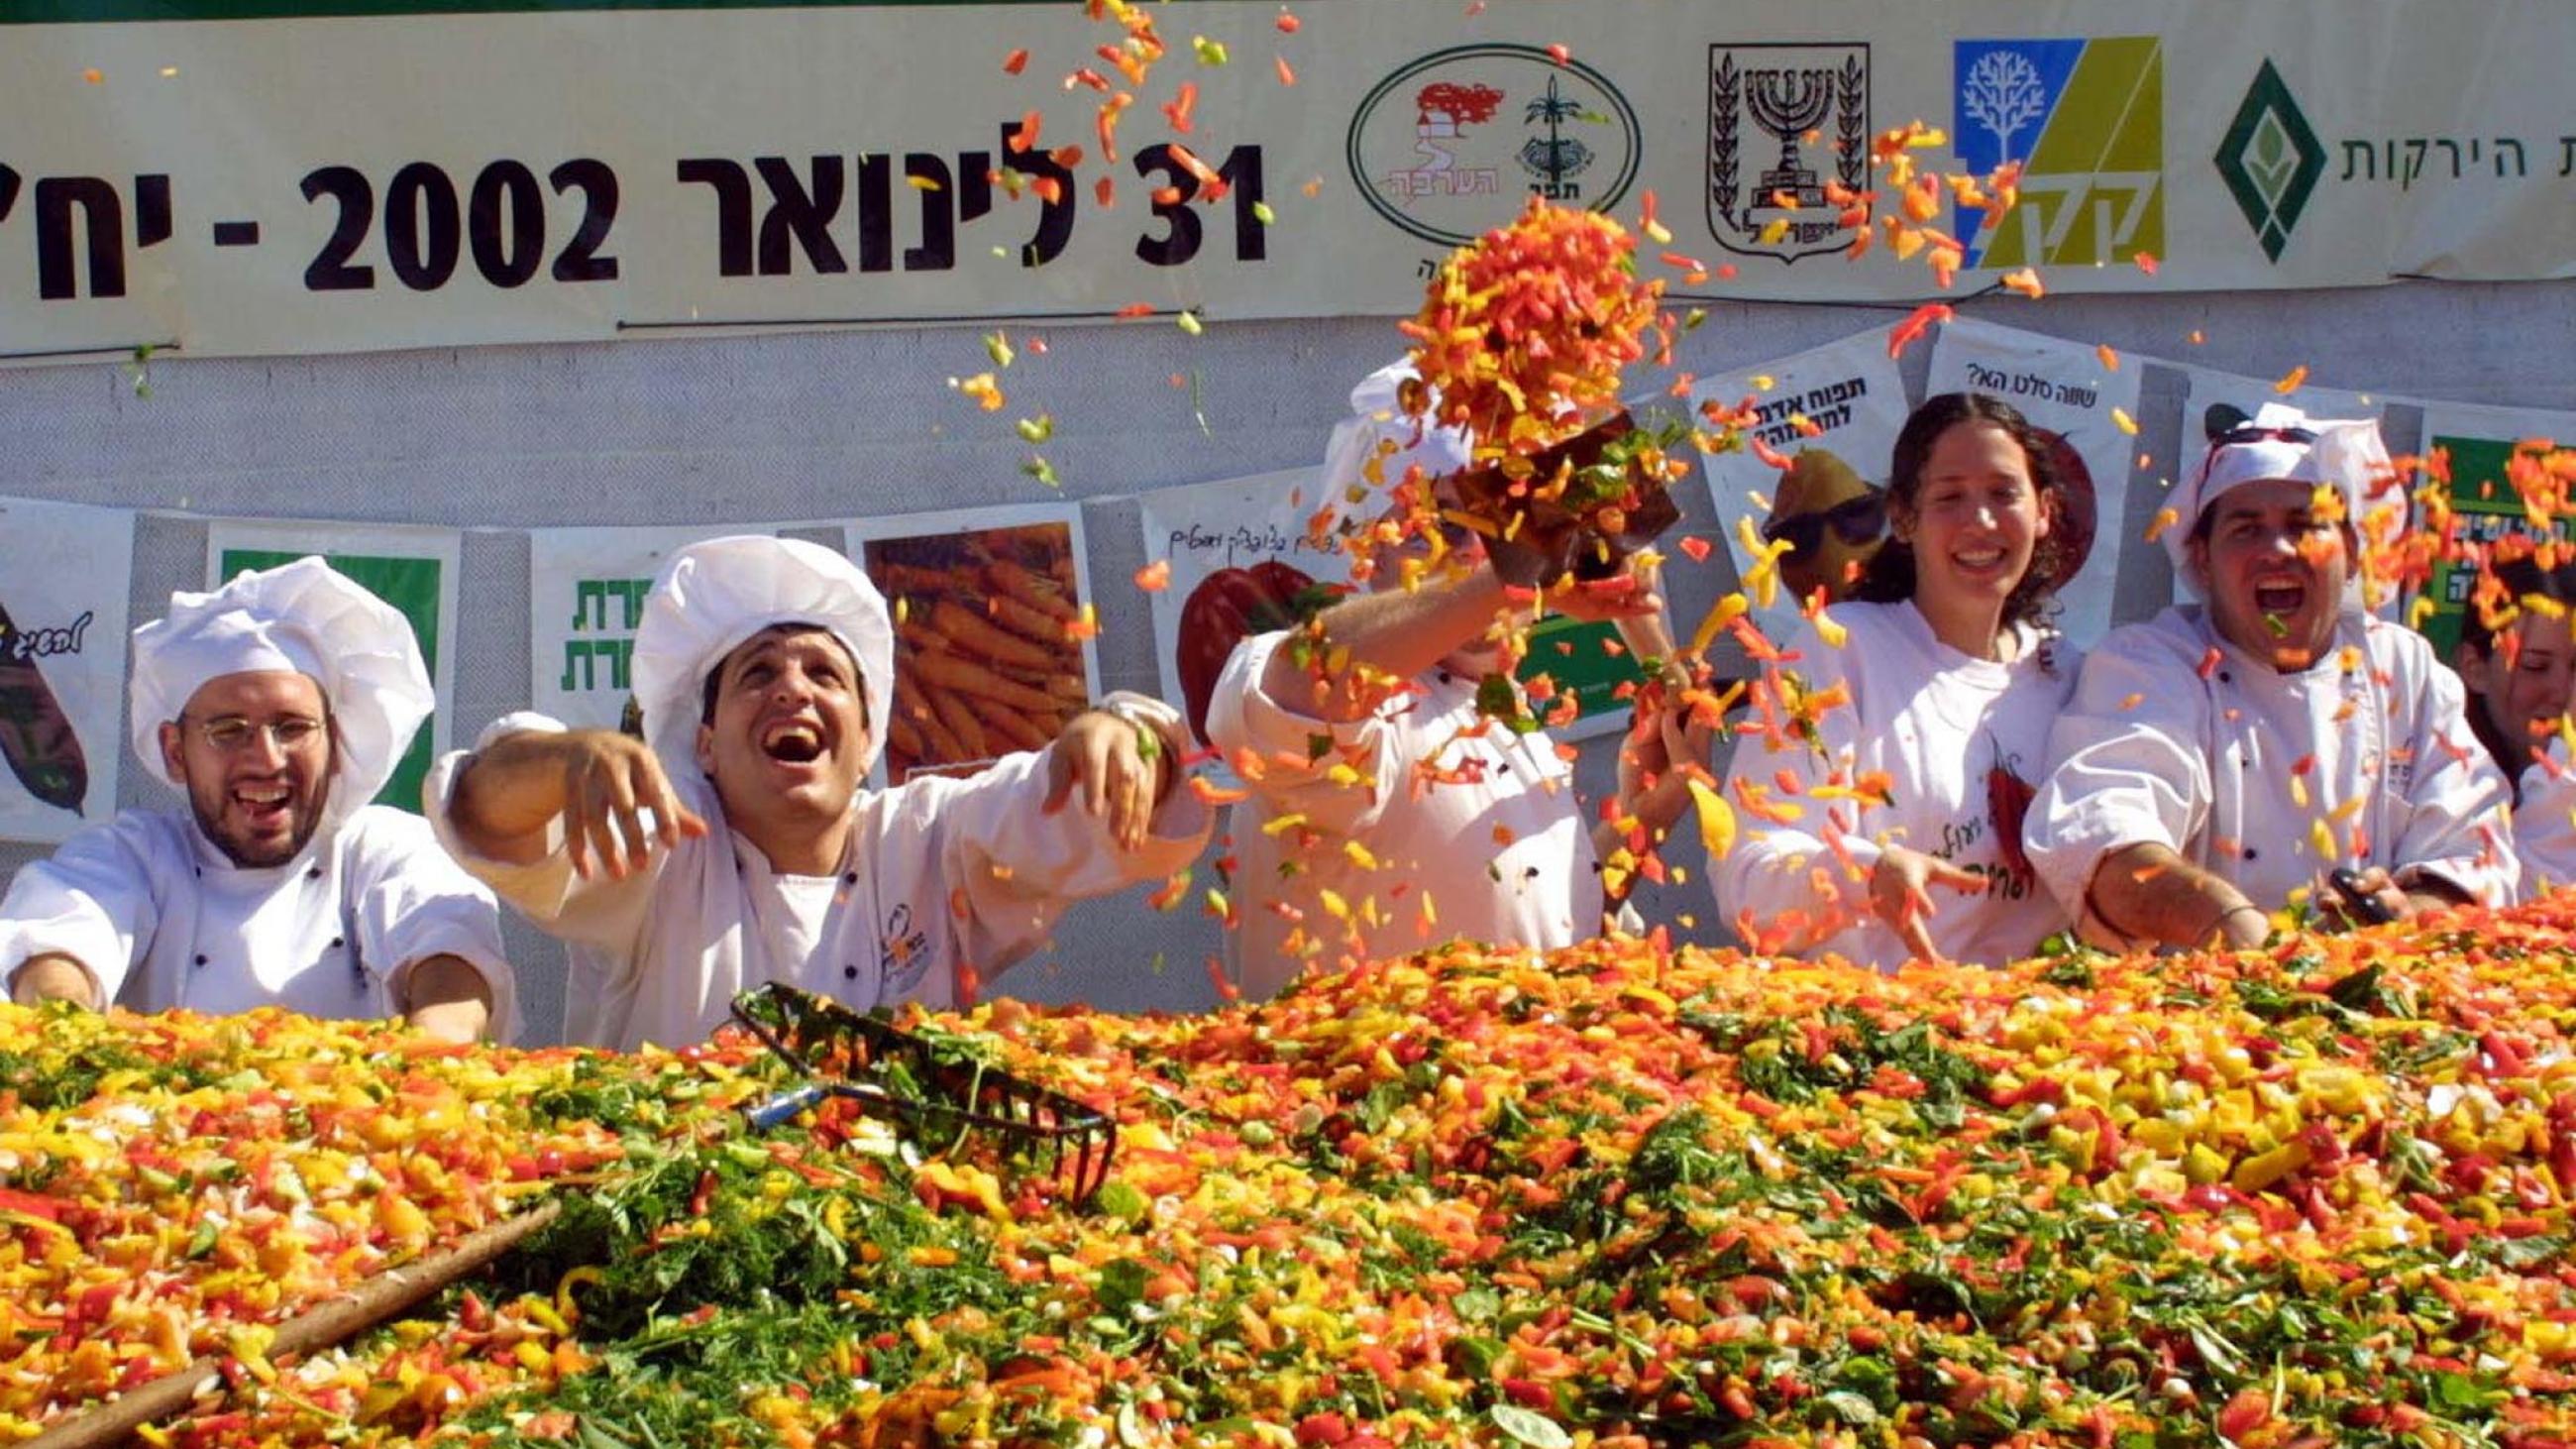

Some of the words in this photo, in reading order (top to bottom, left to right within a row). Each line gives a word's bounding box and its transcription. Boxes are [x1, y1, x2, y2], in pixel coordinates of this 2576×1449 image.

[2340, 138, 2526, 191] הירקות
[298, 159, 620, 291] 2002
[676, 121, 1077, 278] לינואר
[1134, 143, 1266, 268] 31
[1743, 207, 1835, 245] ישרל
[1752, 394, 1804, 424] אדמ
[1807, 377, 1867, 409] תפוח
